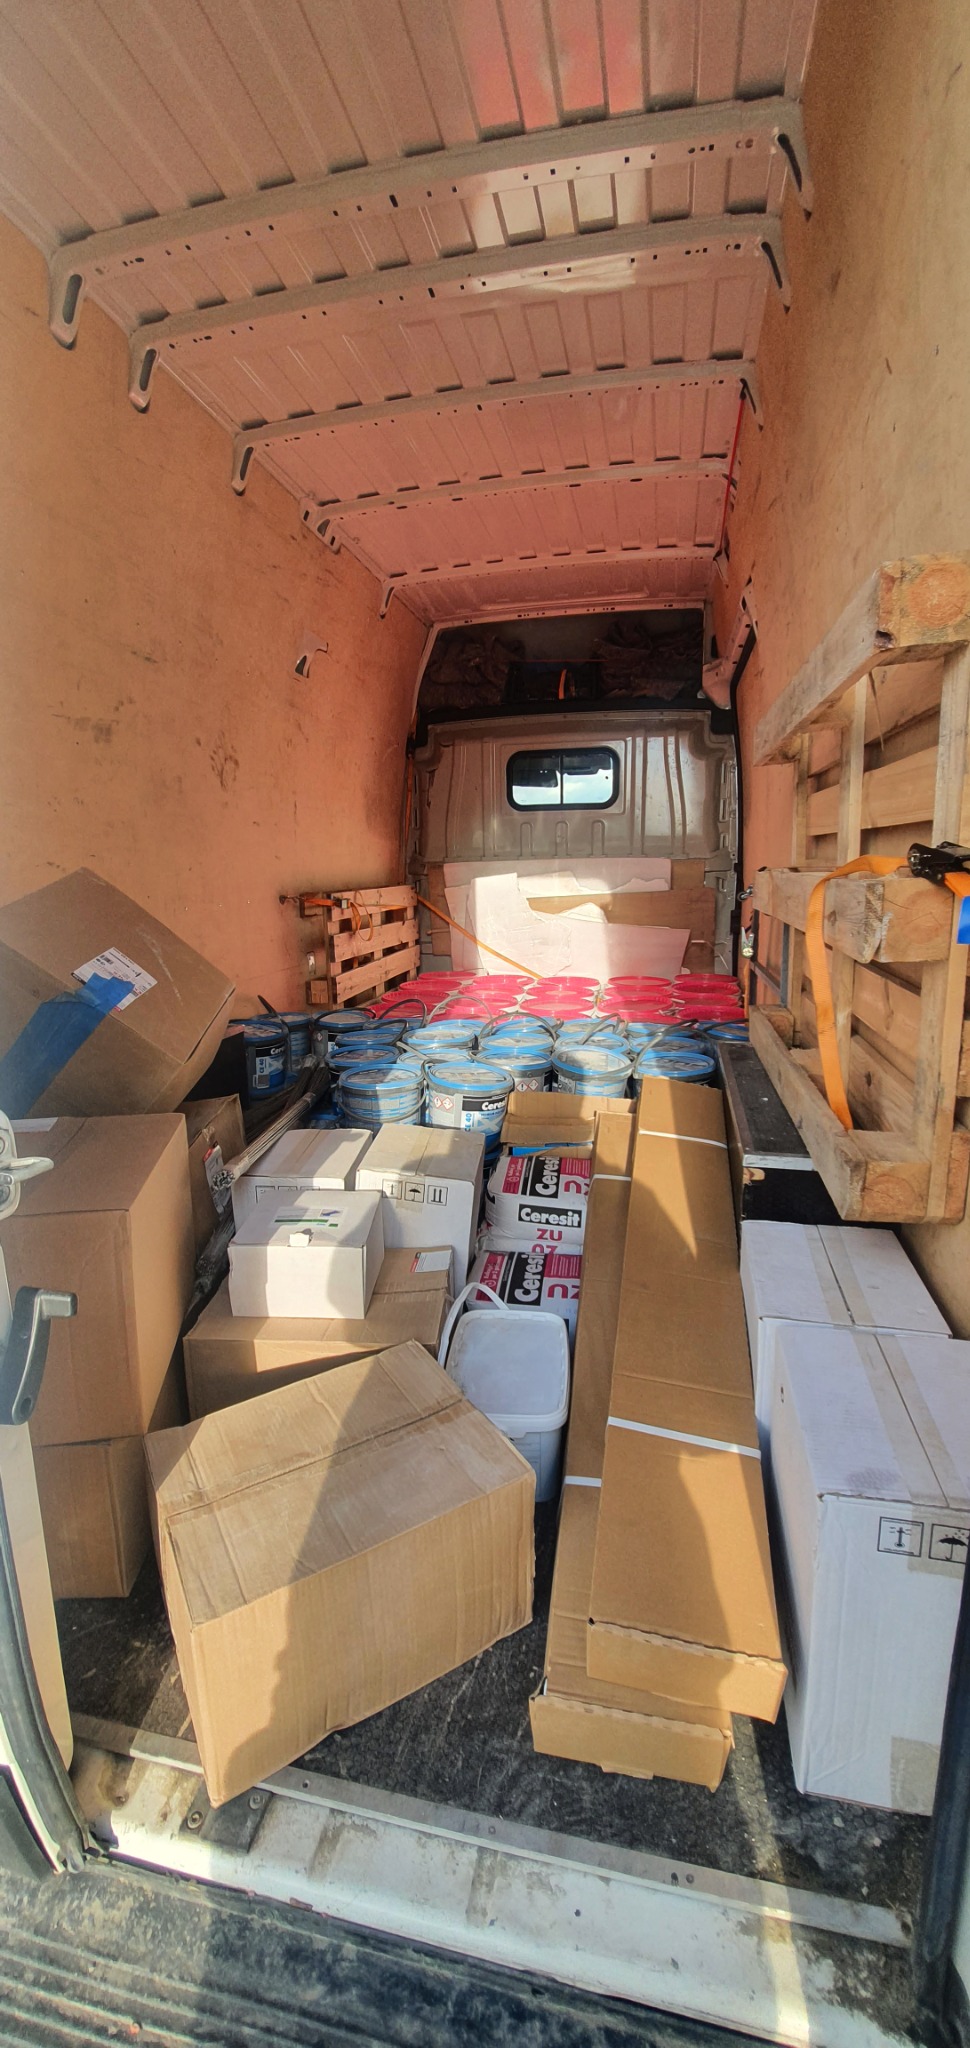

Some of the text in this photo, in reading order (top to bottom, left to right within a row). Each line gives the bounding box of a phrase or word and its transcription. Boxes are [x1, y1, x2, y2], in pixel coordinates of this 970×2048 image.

[534, 1156, 560, 1196] Ceresi
[520, 1207, 581, 1227] Ceresit
[536, 1228, 563, 1241] ZU
[514, 1254, 546, 1303] Ceresi
